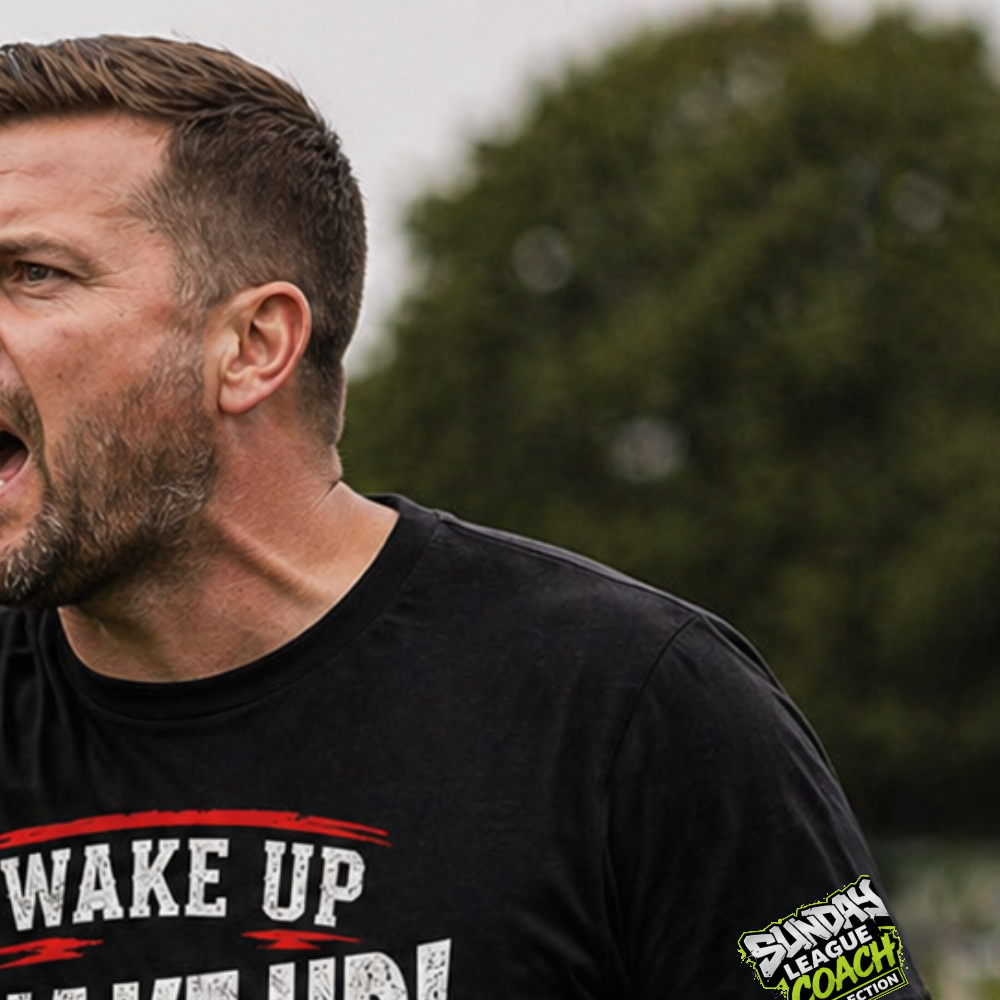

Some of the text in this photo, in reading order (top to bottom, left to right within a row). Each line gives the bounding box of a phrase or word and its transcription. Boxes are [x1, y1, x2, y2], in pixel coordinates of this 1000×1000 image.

[0, 838, 366, 931] WAKE UP
[743, 878, 890, 978] SUNDAY
[783, 924, 873, 981] LEAGUE
